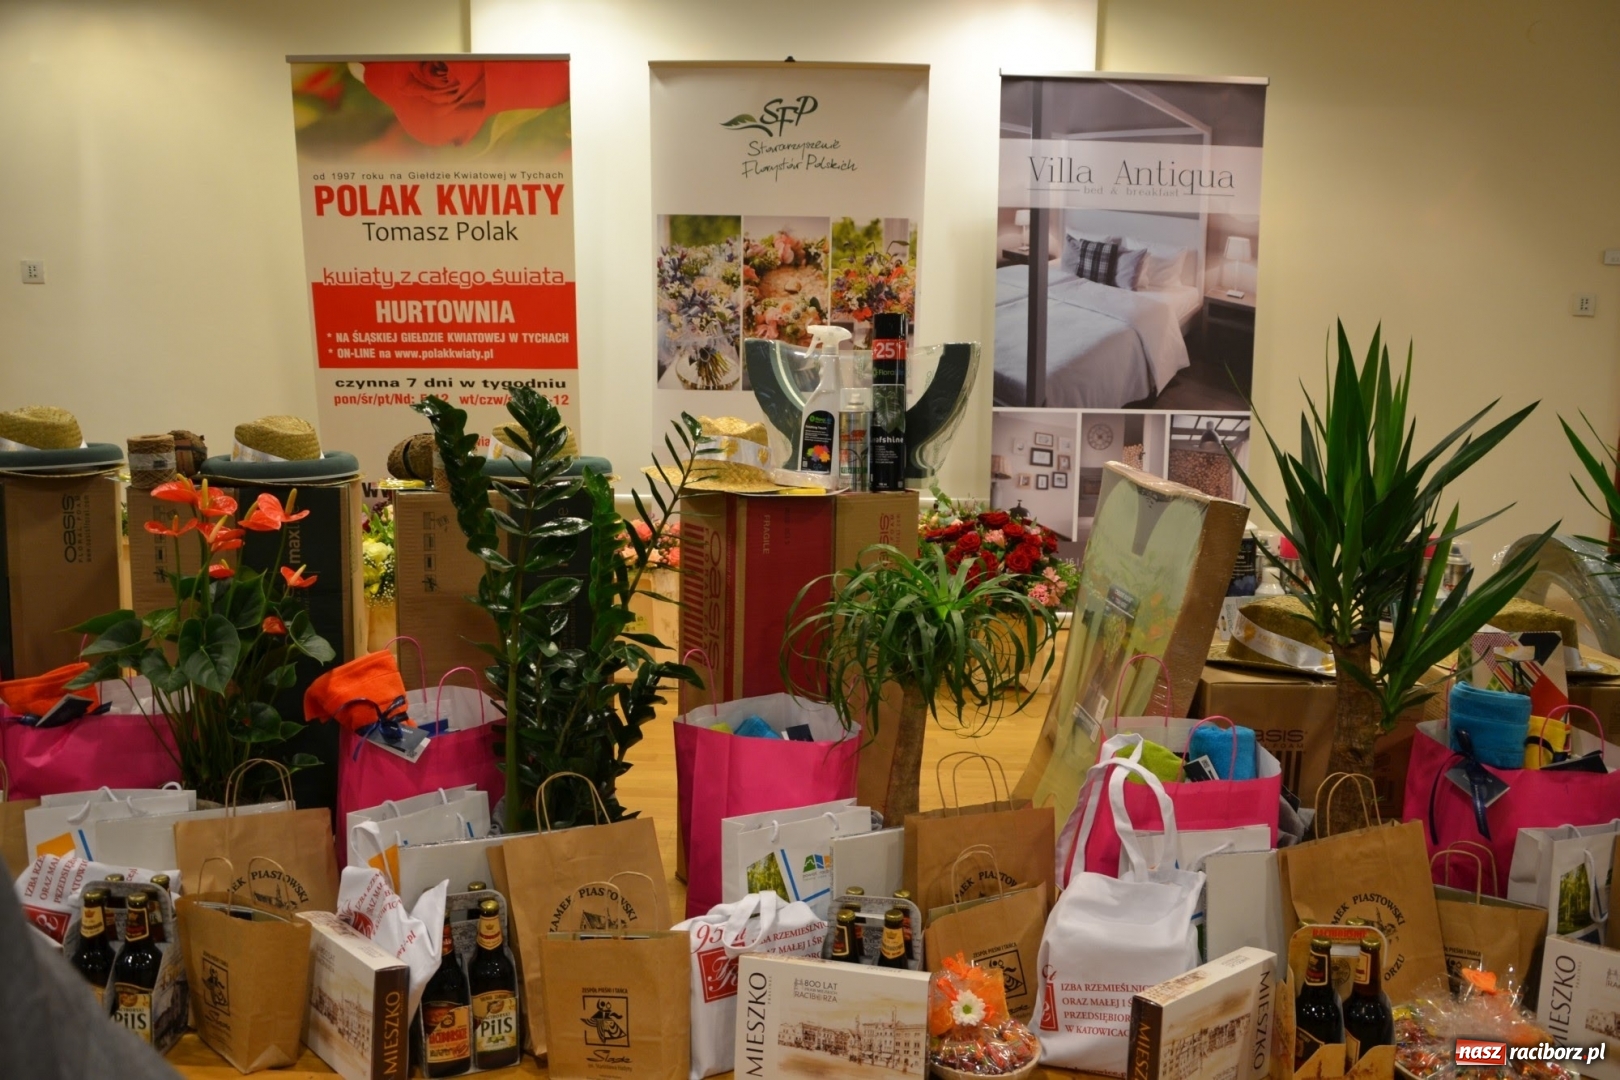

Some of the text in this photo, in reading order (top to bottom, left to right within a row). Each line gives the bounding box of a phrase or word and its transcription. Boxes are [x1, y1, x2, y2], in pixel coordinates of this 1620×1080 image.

[806, 154, 858, 172] Polskich
[313, 172, 325, 180] od
[331, 172, 356, 180] 1997
[362, 172, 384, 180] roku
[408, 171, 451, 180] Giełdzie
[453, 171, 507, 181] Kwiatowej
[520, 171, 564, 181] Tychach
[1028, 156, 1235, 195] Villa Antiqua
[314, 184, 565, 217] POLAK KWIATY
[1083, 185, 1104, 195] bed
[1126, 187, 1179, 198] breakfast
[362, 220, 518, 242] Tomasz Polak
[323, 267, 565, 288] kwiaty z całego świata
[375, 300, 515, 323] HURTOWNIA
[336, 330, 569, 345] NA ŚLĄSKIEJ GIEŁDZIE KWIATOWEJ W TYCHACH
[337, 348, 494, 361] ON-LINE na www.polakkwiaty.pl
[335, 378, 566, 390] czynna 7 dni w tygodniu
[1352, 893, 1406, 925] PIASTOWSKI
[1061, 983, 1082, 991] IZBA
[1062, 997, 1088, 1006] ORAZ
[1090, 998, 1120, 1008] MAŁEJ
[746, 972, 767, 1077] MIESZKO
[1063, 1011, 1132, 1023] PRZEDSIĘBIOR
[1253, 971, 1271, 1070] MIESZKO
[384, 991, 401, 1075] MIESZKO
[1065, 1025, 1130, 1037] W KATOWICAC
[1134, 1023, 1151, 1080] MIESZ
